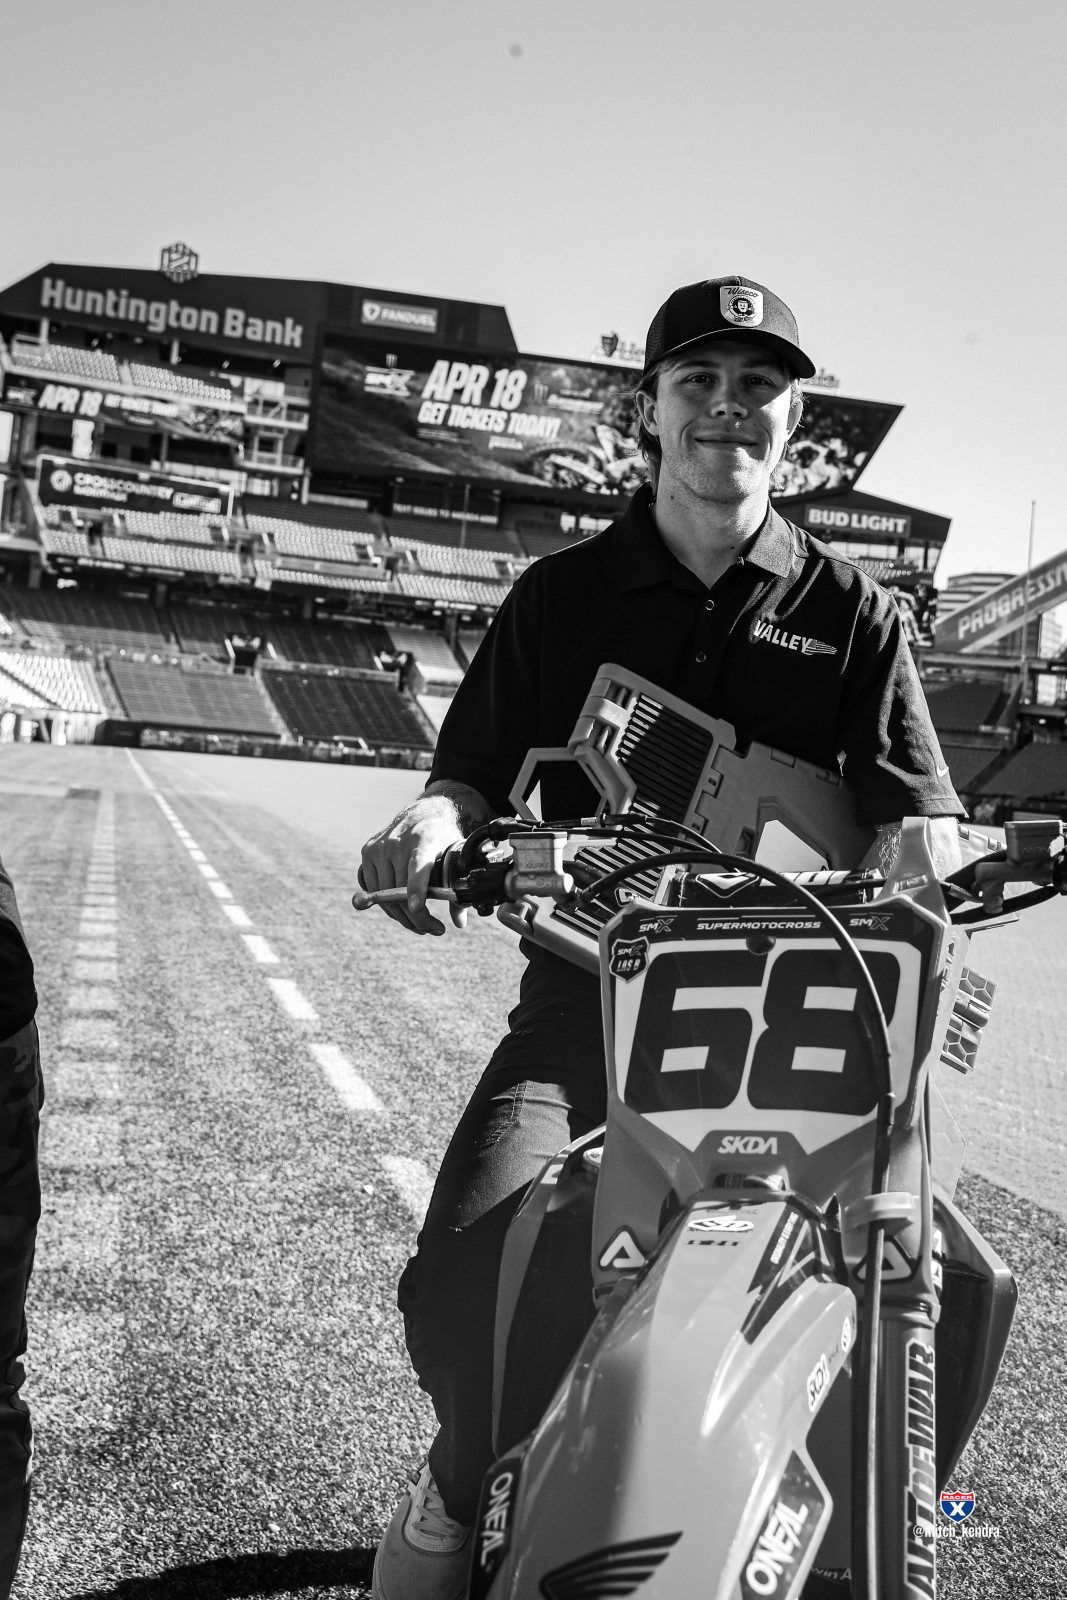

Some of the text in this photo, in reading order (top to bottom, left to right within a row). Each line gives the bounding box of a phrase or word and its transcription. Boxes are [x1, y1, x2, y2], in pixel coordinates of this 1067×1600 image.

[724, 287, 760, 298] Wiseco
[41, 277, 303, 348] Huntington Bank
[380, 307, 437, 327] FANDUEL
[421, 360, 490, 406] APR
[490, 368, 528, 410] 18
[38, 384, 80, 413] APR
[79, 389, 103, 417] 18
[418, 401, 562, 439] GET TICKETS TODAY!
[808, 508, 907, 533] BUD LIGHT
[753, 620, 814, 654] VALLEY
[638, 918, 675, 933] SMX
[696, 921, 822, 931] SUPERMOTOCROSS
[849, 915, 890, 931] SMX
[617, 945, 644, 957] SMX
[624, 949, 900, 1116] 68
[717, 1135, 778, 1155] SKDA
